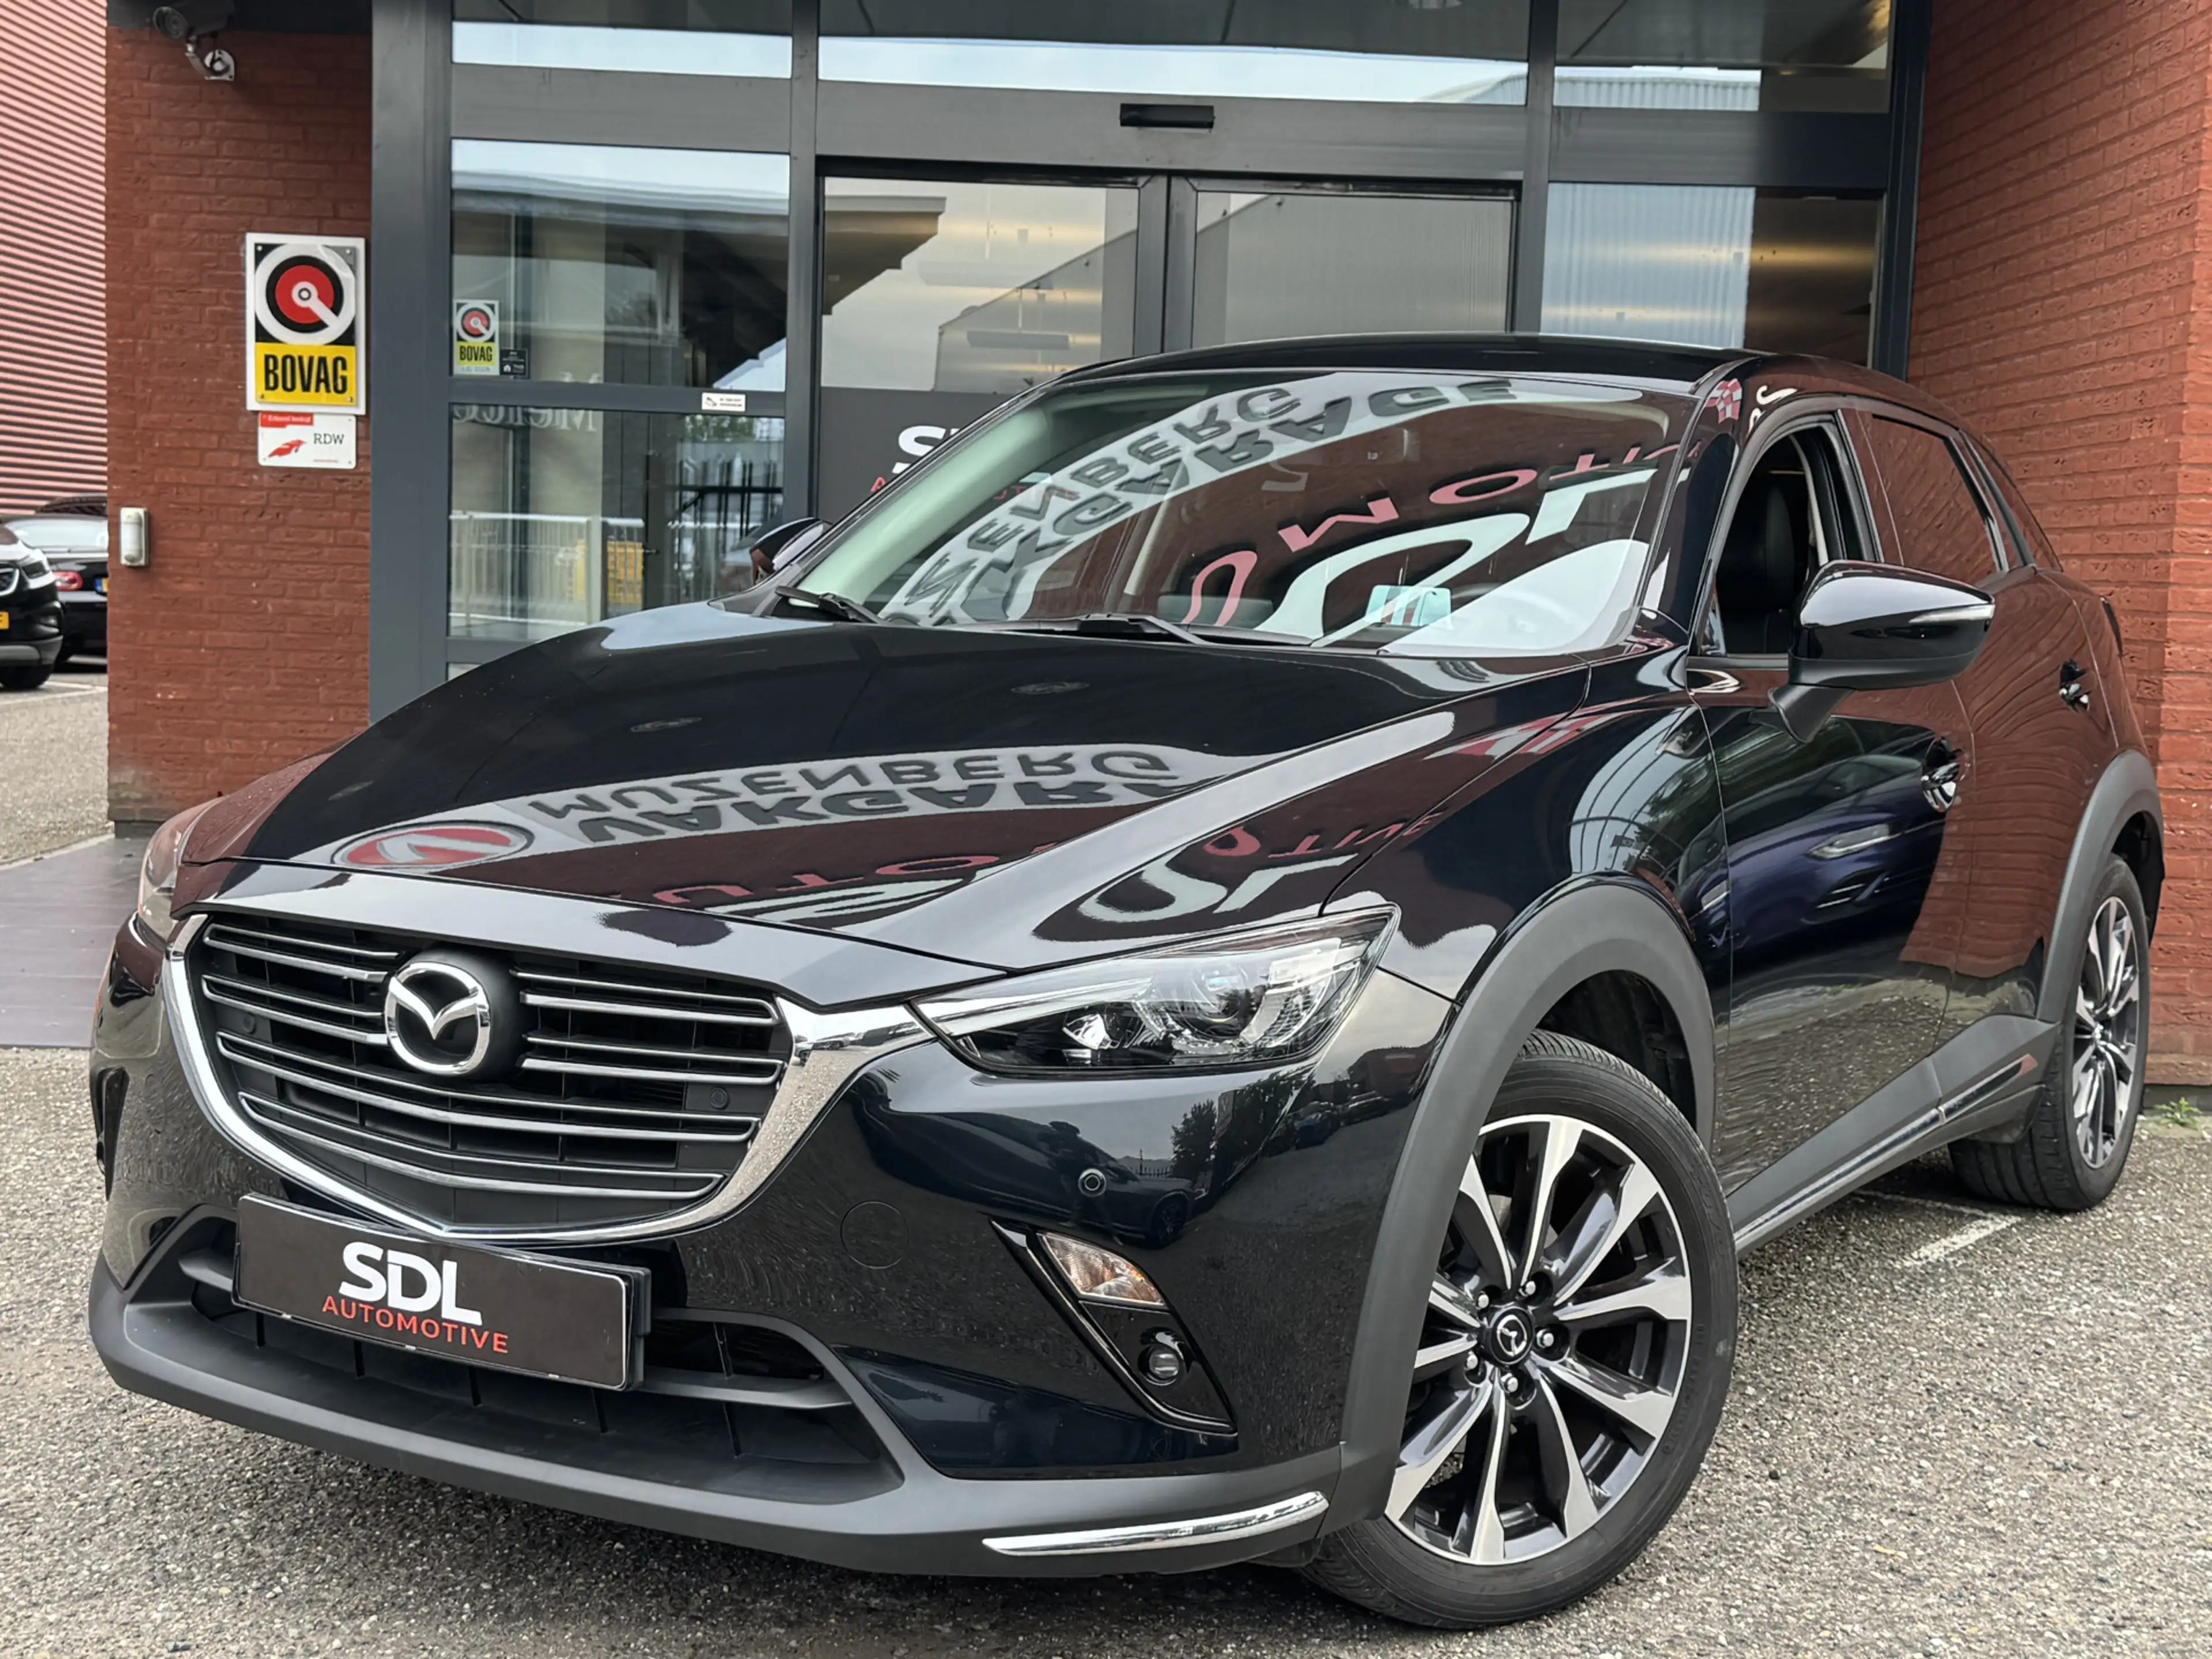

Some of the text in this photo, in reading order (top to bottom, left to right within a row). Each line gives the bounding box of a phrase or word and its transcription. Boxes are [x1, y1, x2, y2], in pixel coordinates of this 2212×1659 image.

[264, 354, 348, 395] BOVAG
[459, 346, 493, 361] BOVAG
[313, 432, 344, 445] RDW
[892, 425, 961, 475] S
[338, 1241, 482, 1325] SDL
[321, 1296, 509, 1354] AUTOMOTIVE
